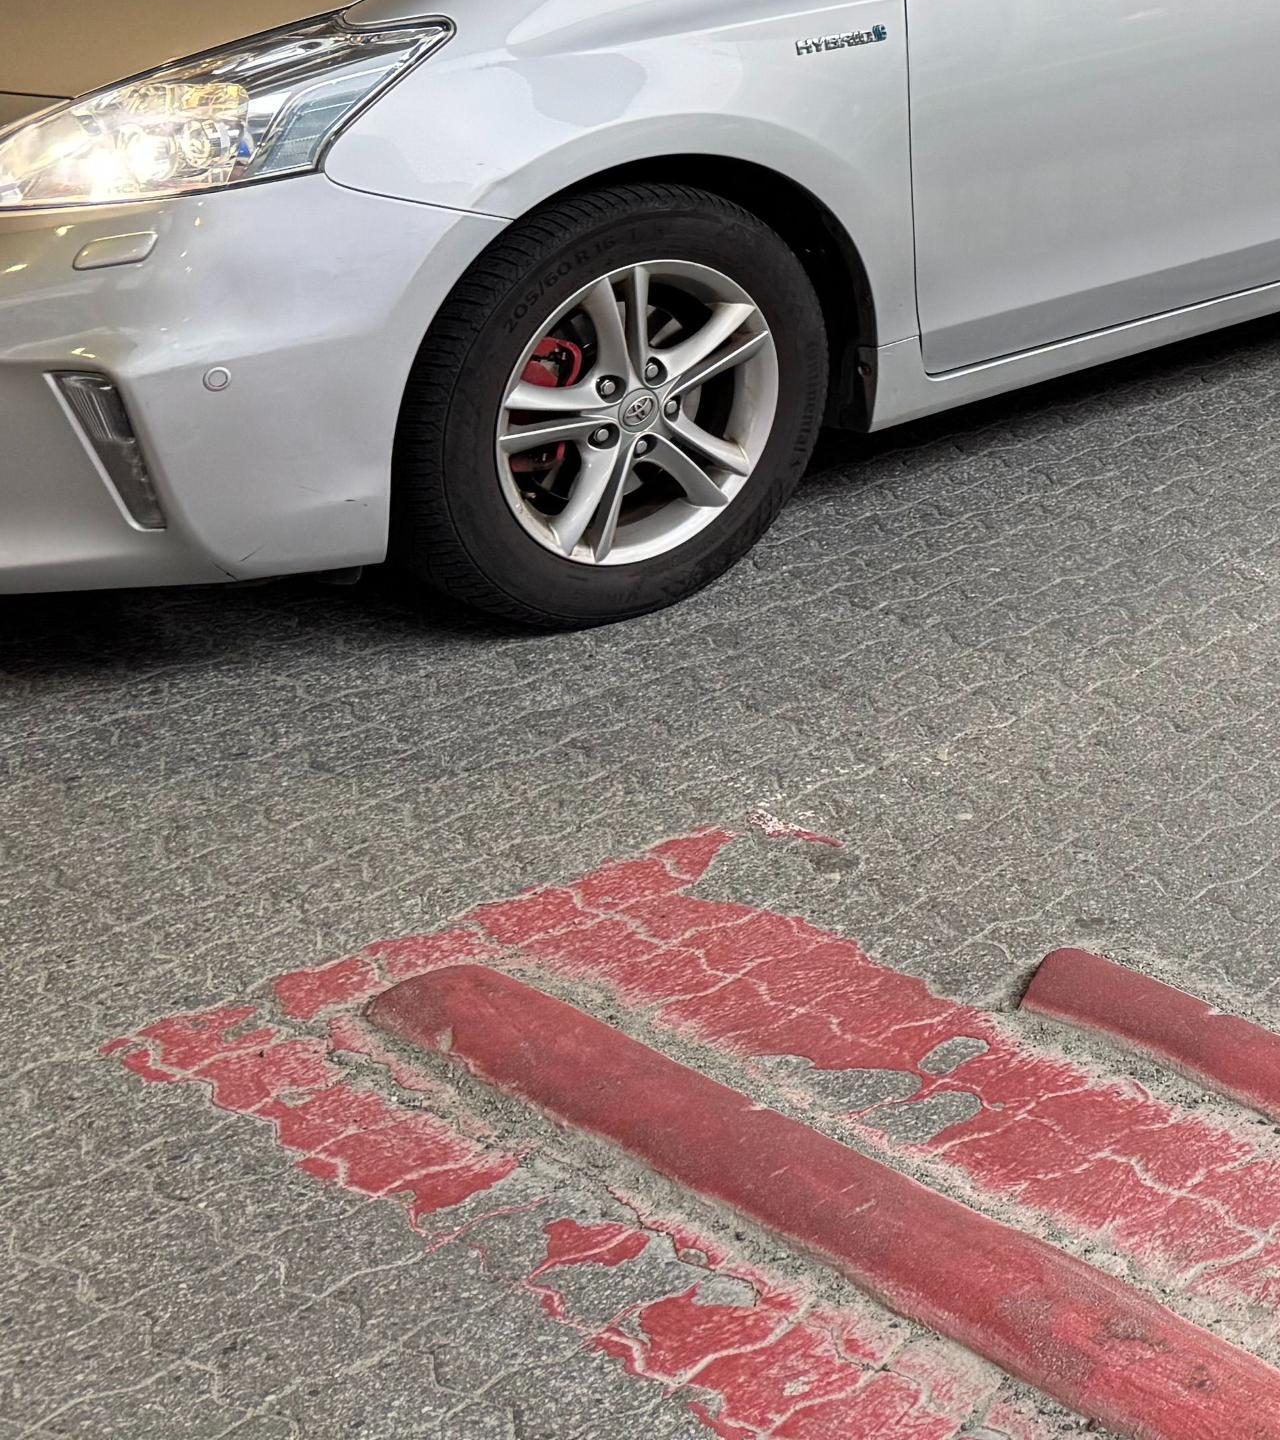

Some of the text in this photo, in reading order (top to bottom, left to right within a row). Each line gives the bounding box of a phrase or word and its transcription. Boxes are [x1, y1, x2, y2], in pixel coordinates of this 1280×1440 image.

[504, 235, 616, 333] 205/60 R 16
